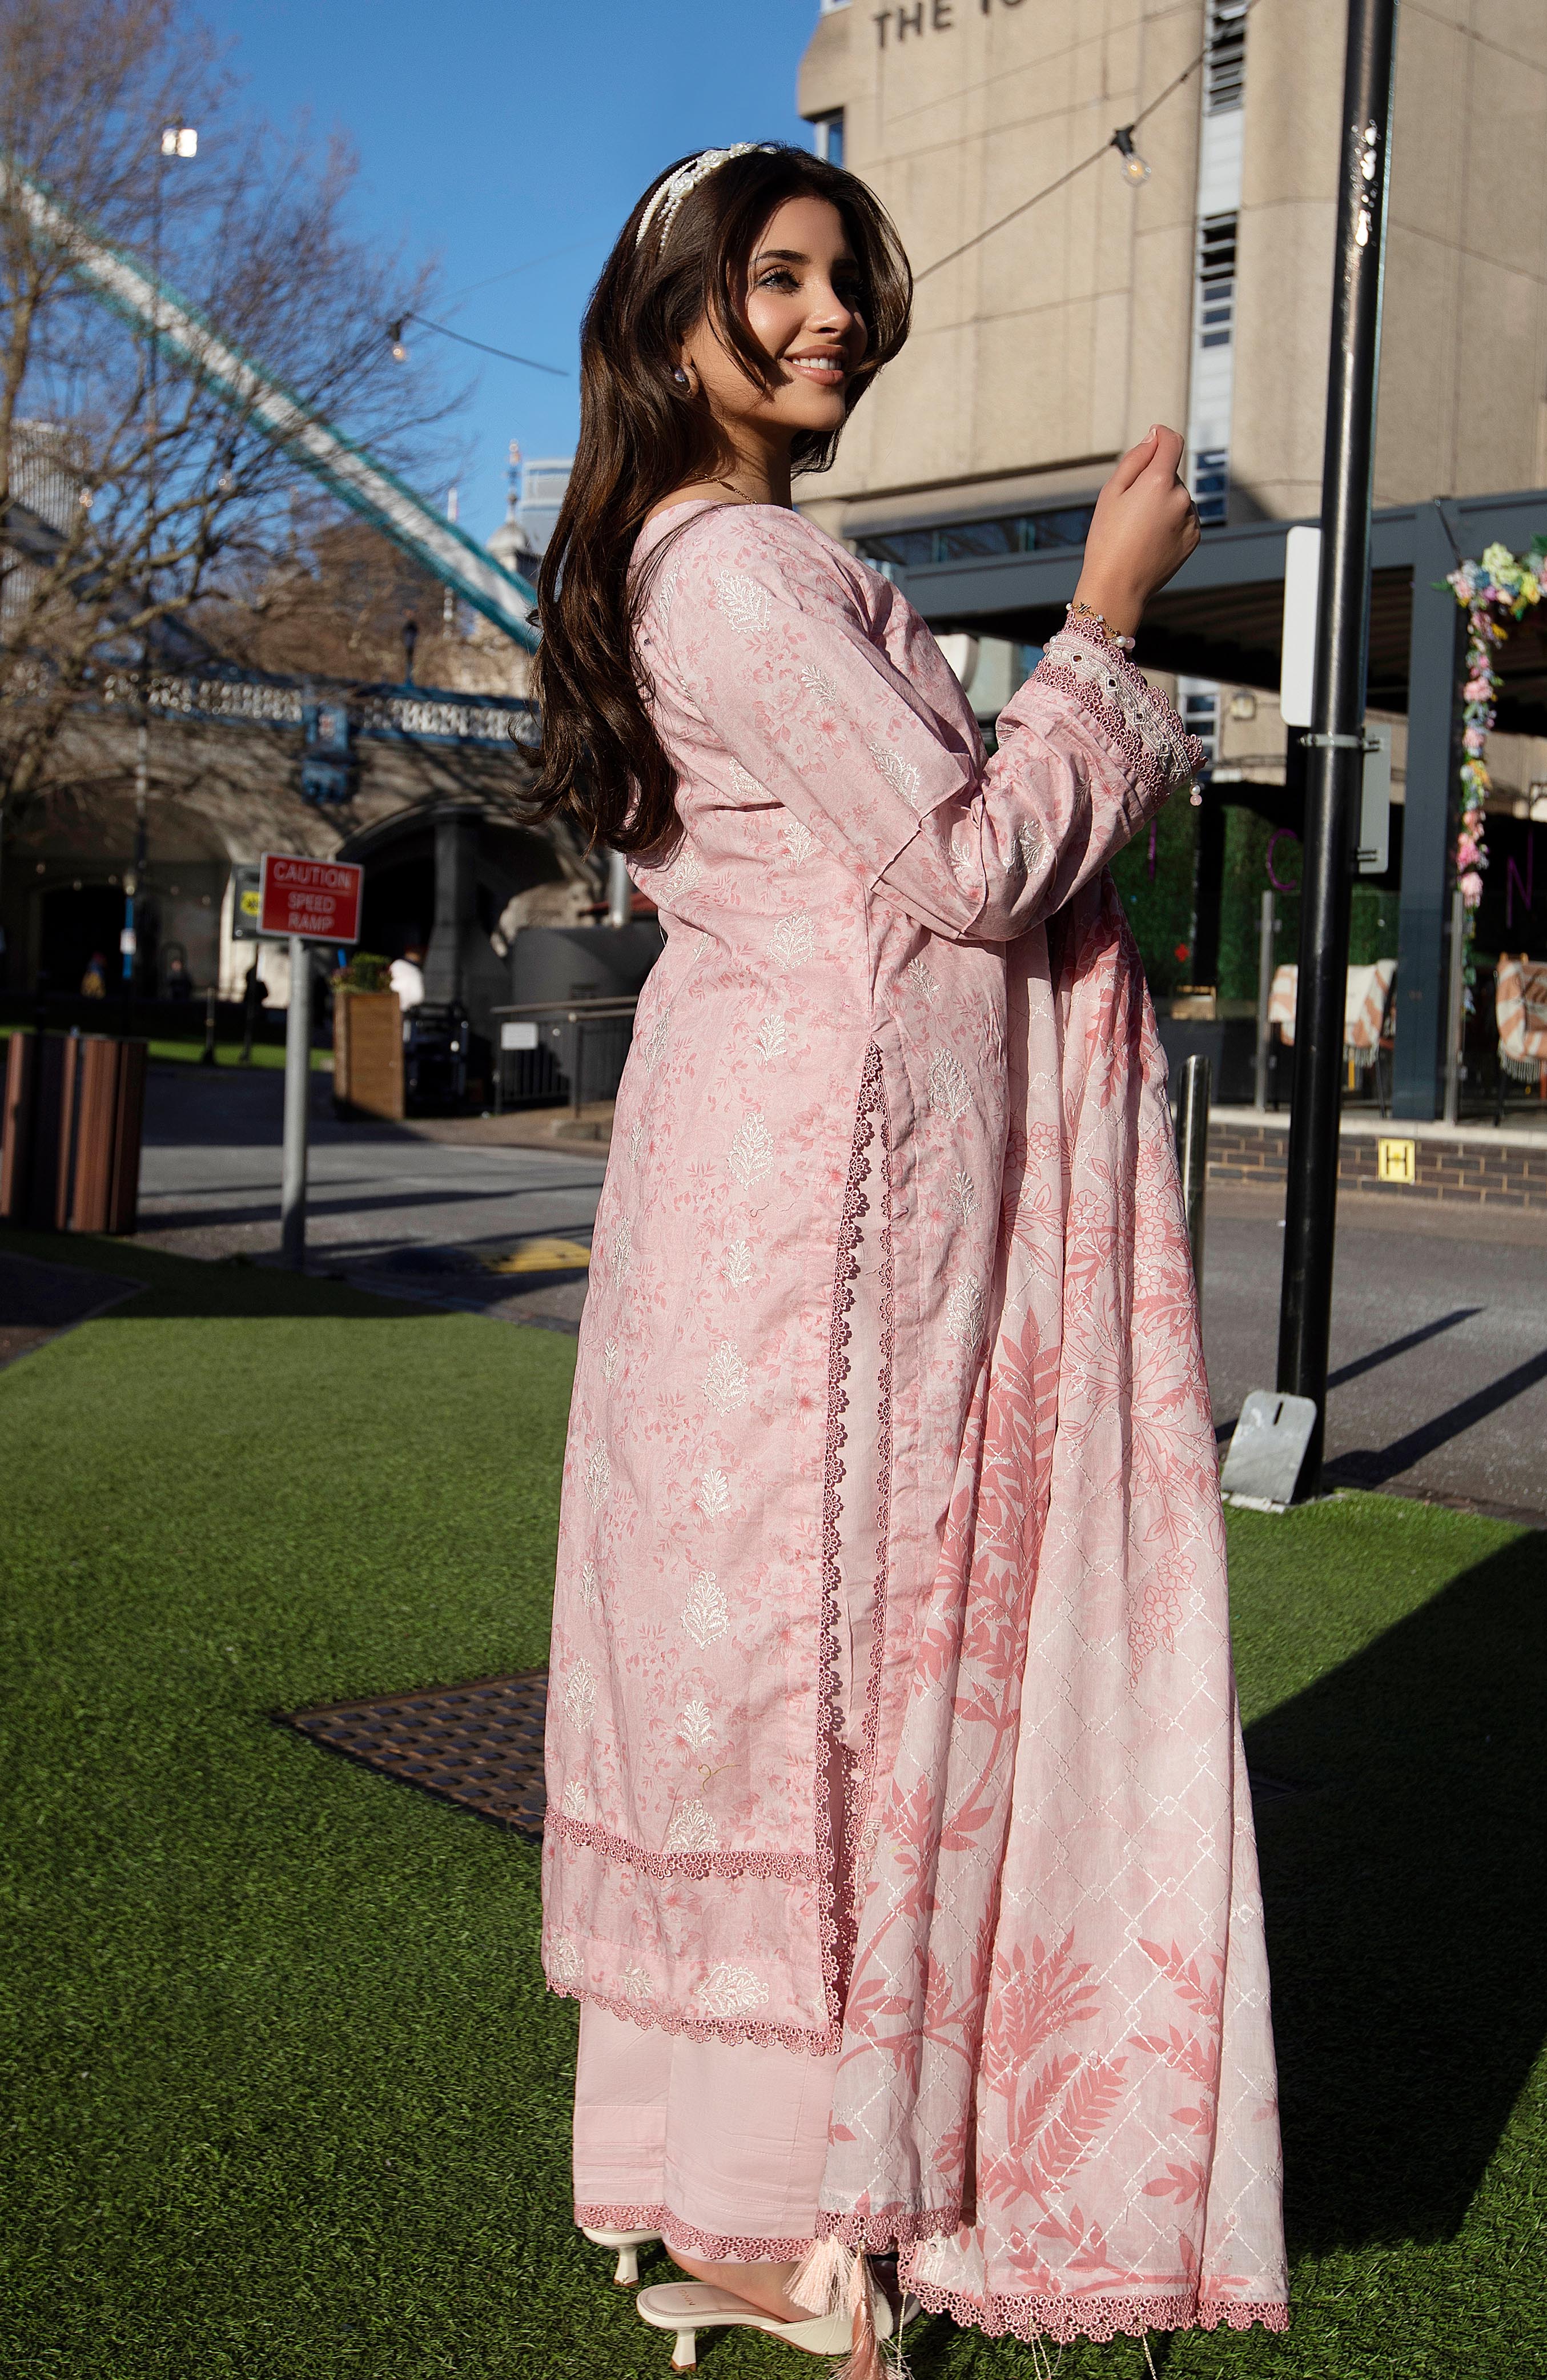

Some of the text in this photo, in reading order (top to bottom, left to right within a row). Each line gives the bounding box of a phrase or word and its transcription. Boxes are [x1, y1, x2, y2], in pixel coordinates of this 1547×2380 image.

[874, 0, 953, 48] THE
[274, 861, 351, 887] CAUTION
[288, 892, 335, 912] SPEED
[288, 912, 334, 931] RAMP
[1386, 1145, 1408, 1176] H
